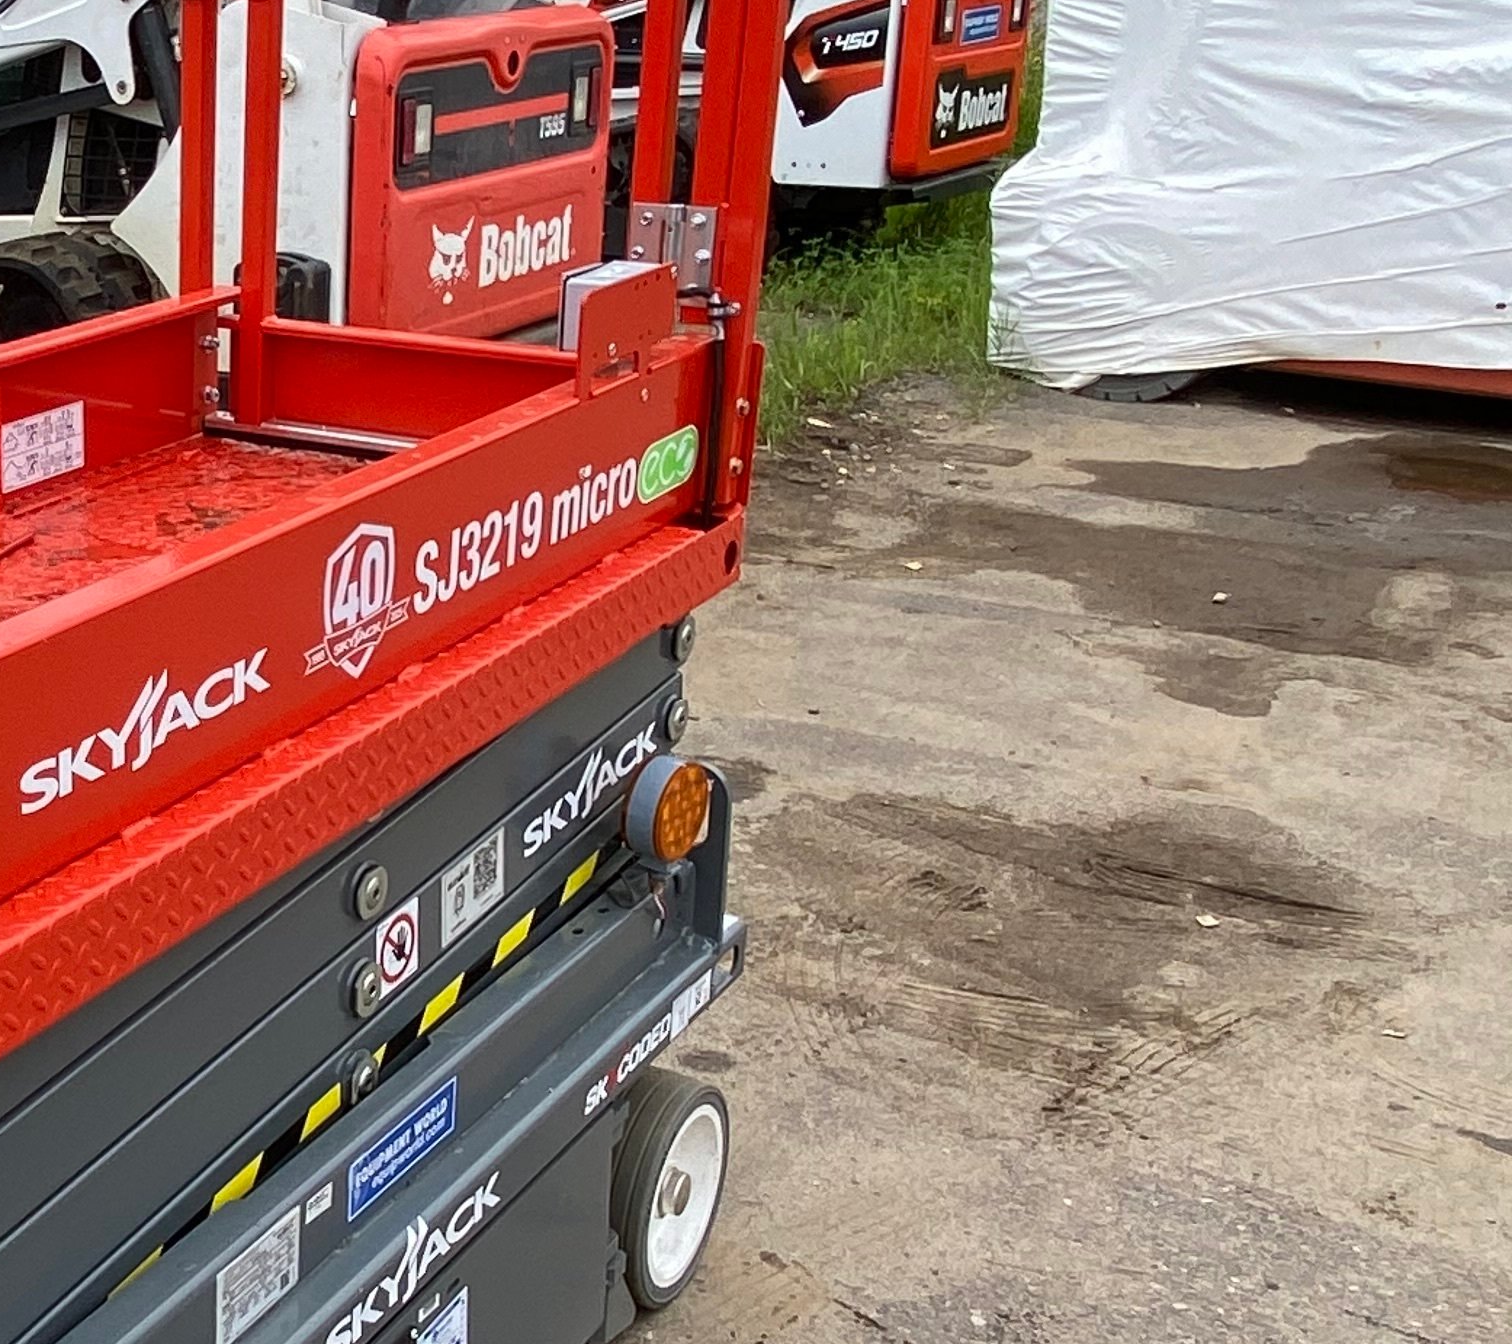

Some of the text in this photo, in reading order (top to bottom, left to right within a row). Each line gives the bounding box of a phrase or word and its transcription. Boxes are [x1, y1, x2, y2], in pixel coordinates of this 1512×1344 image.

[957, 83, 1008, 132] Bobcat
[478, 203, 572, 288] Bobcat
[332, 540, 386, 627] 40
[412, 490, 544, 615] SJ3219
[549, 457, 638, 545] micro
[19, 646, 271, 815] SKYJACK
[523, 721, 658, 858] SKYJACK
